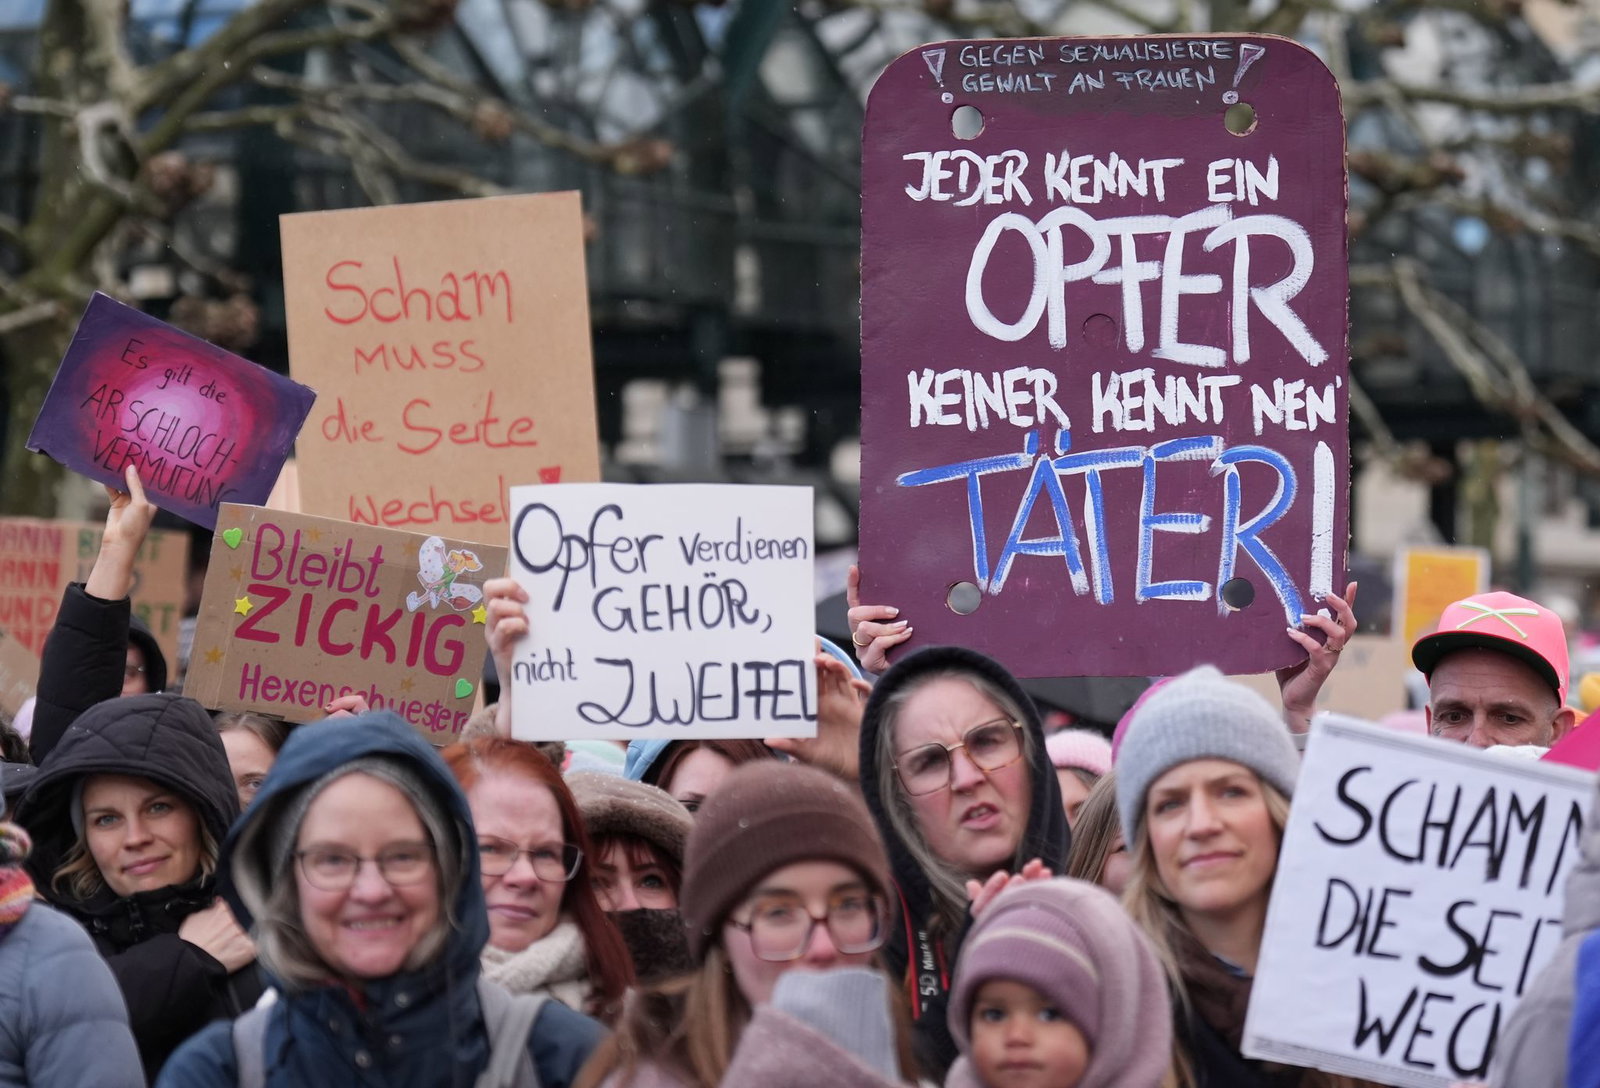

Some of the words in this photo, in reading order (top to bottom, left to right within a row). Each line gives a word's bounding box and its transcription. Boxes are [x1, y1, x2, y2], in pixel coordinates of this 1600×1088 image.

[959, 44, 1045, 66] GEGEN
[1058, 40, 1234, 63] SEXUALISIERTE
[960, 71, 1057, 94] GEWALT
[1068, 73, 1106, 94] AN
[1112, 66, 1217, 92] FRAUEN
[902, 148, 1034, 207] JEDER
[1045, 148, 1185, 205] KENNT
[1206, 152, 1280, 206] EIN
[324, 255, 514, 325] Scham
[964, 203, 1330, 367] OPFER
[120, 338, 149, 370] Es
[156, 364, 193, 390] gilt
[199, 378, 227, 405] die
[907, 365, 1072, 432] KEINER
[1091, 366, 1243, 434] KENNT
[321, 396, 384, 444] die
[396, 389, 538, 455] Seite
[250, 522, 386, 598] Bleibt
[512, 502, 664, 612] Opfer
[233, 582, 467, 676] ZICKIG
[591, 571, 773, 634] GEHÖR,
[512, 647, 578, 686] nicht
[576, 656, 818, 728] ZWEIFEL
[1313, 766, 1548, 890] SCHAM
[1314, 877, 1414, 960] DIE
[919, 974, 939, 996] 5D
